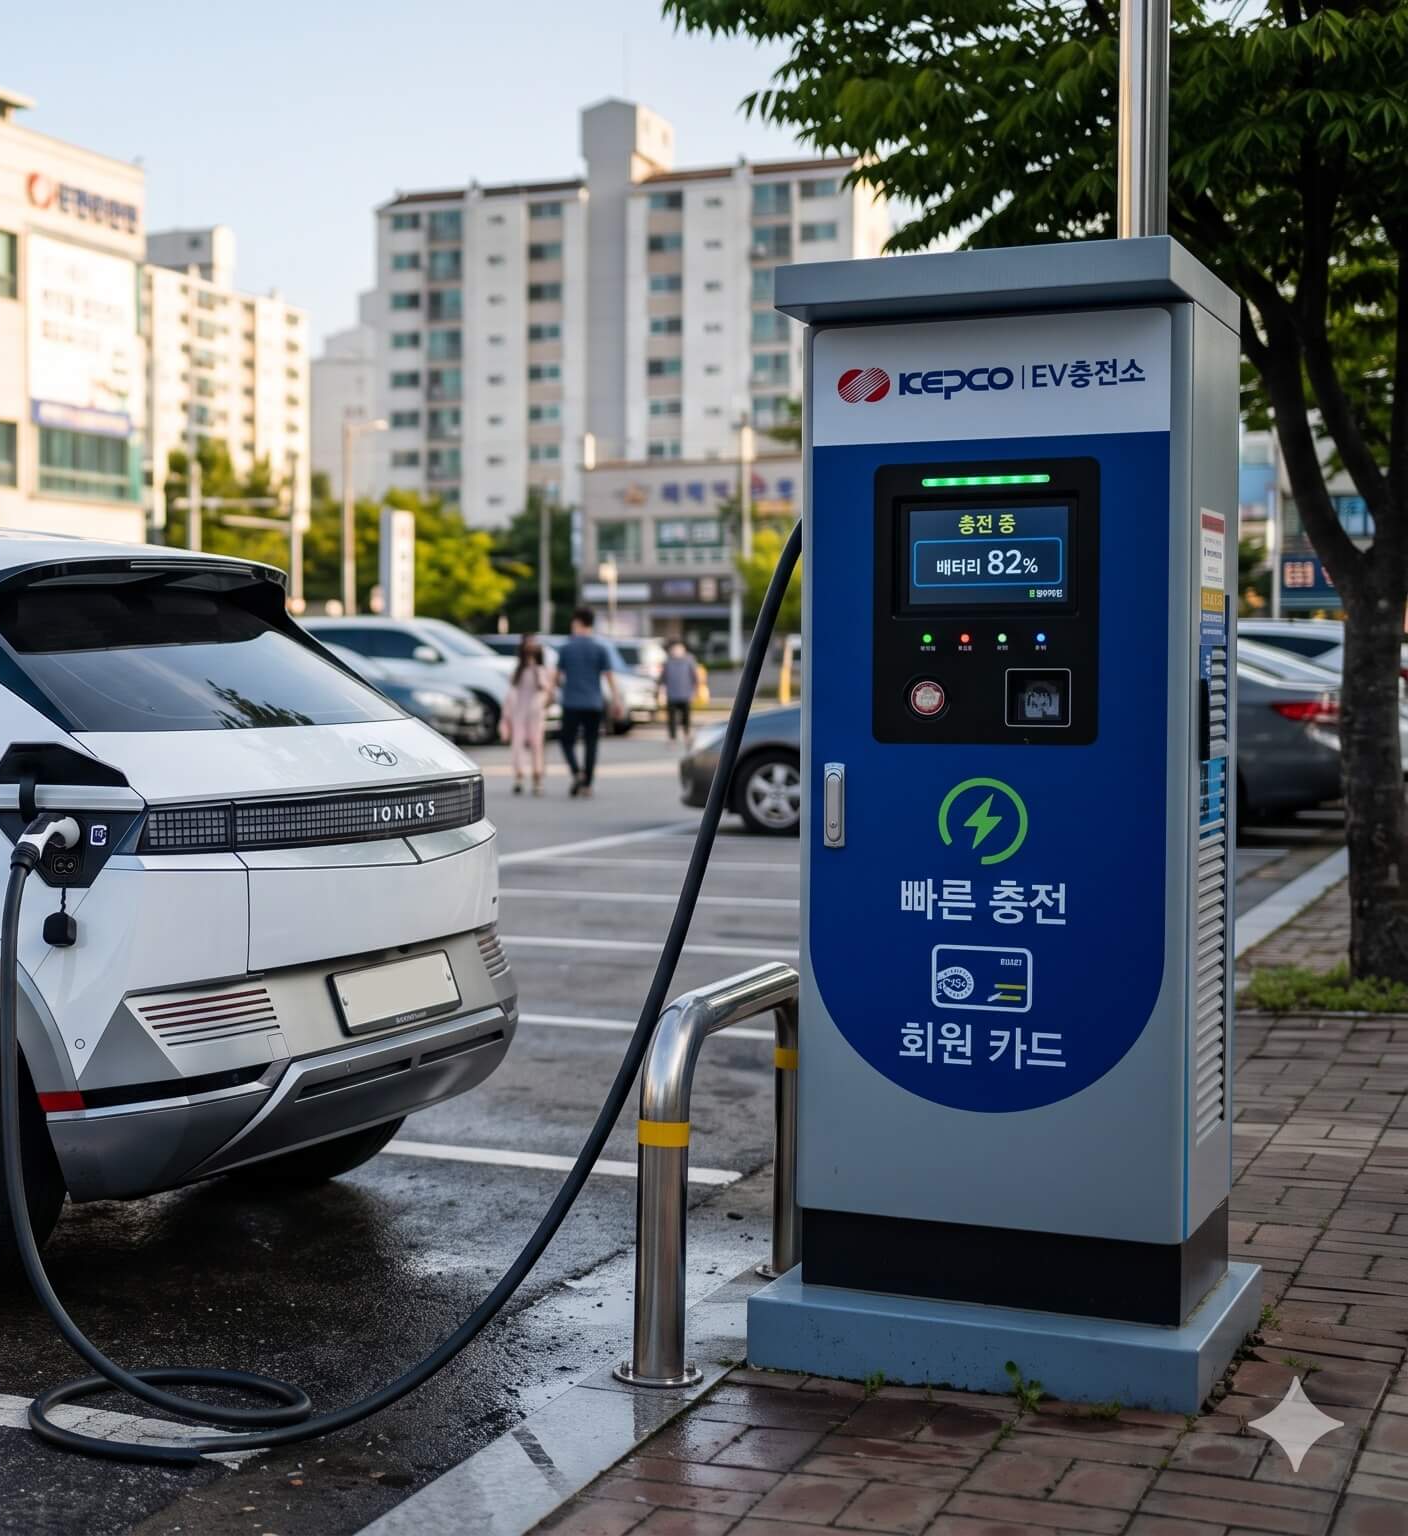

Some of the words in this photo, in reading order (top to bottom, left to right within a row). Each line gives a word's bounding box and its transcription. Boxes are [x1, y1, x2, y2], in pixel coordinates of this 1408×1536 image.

[898, 366, 1014, 400] KEPCO
[1031, 358, 1146, 388] EV충전소
[958, 514, 993, 535] 충전
[998, 513, 1016, 534] 중
[936, 558, 981, 577] 배터리
[987, 549, 1039, 575] 82%
[900, 878, 977, 921] 빠른
[988, 879, 1067, 926] 충전
[898, 1021, 973, 1066] 회원
[988, 1027, 1067, 1070] 카드
